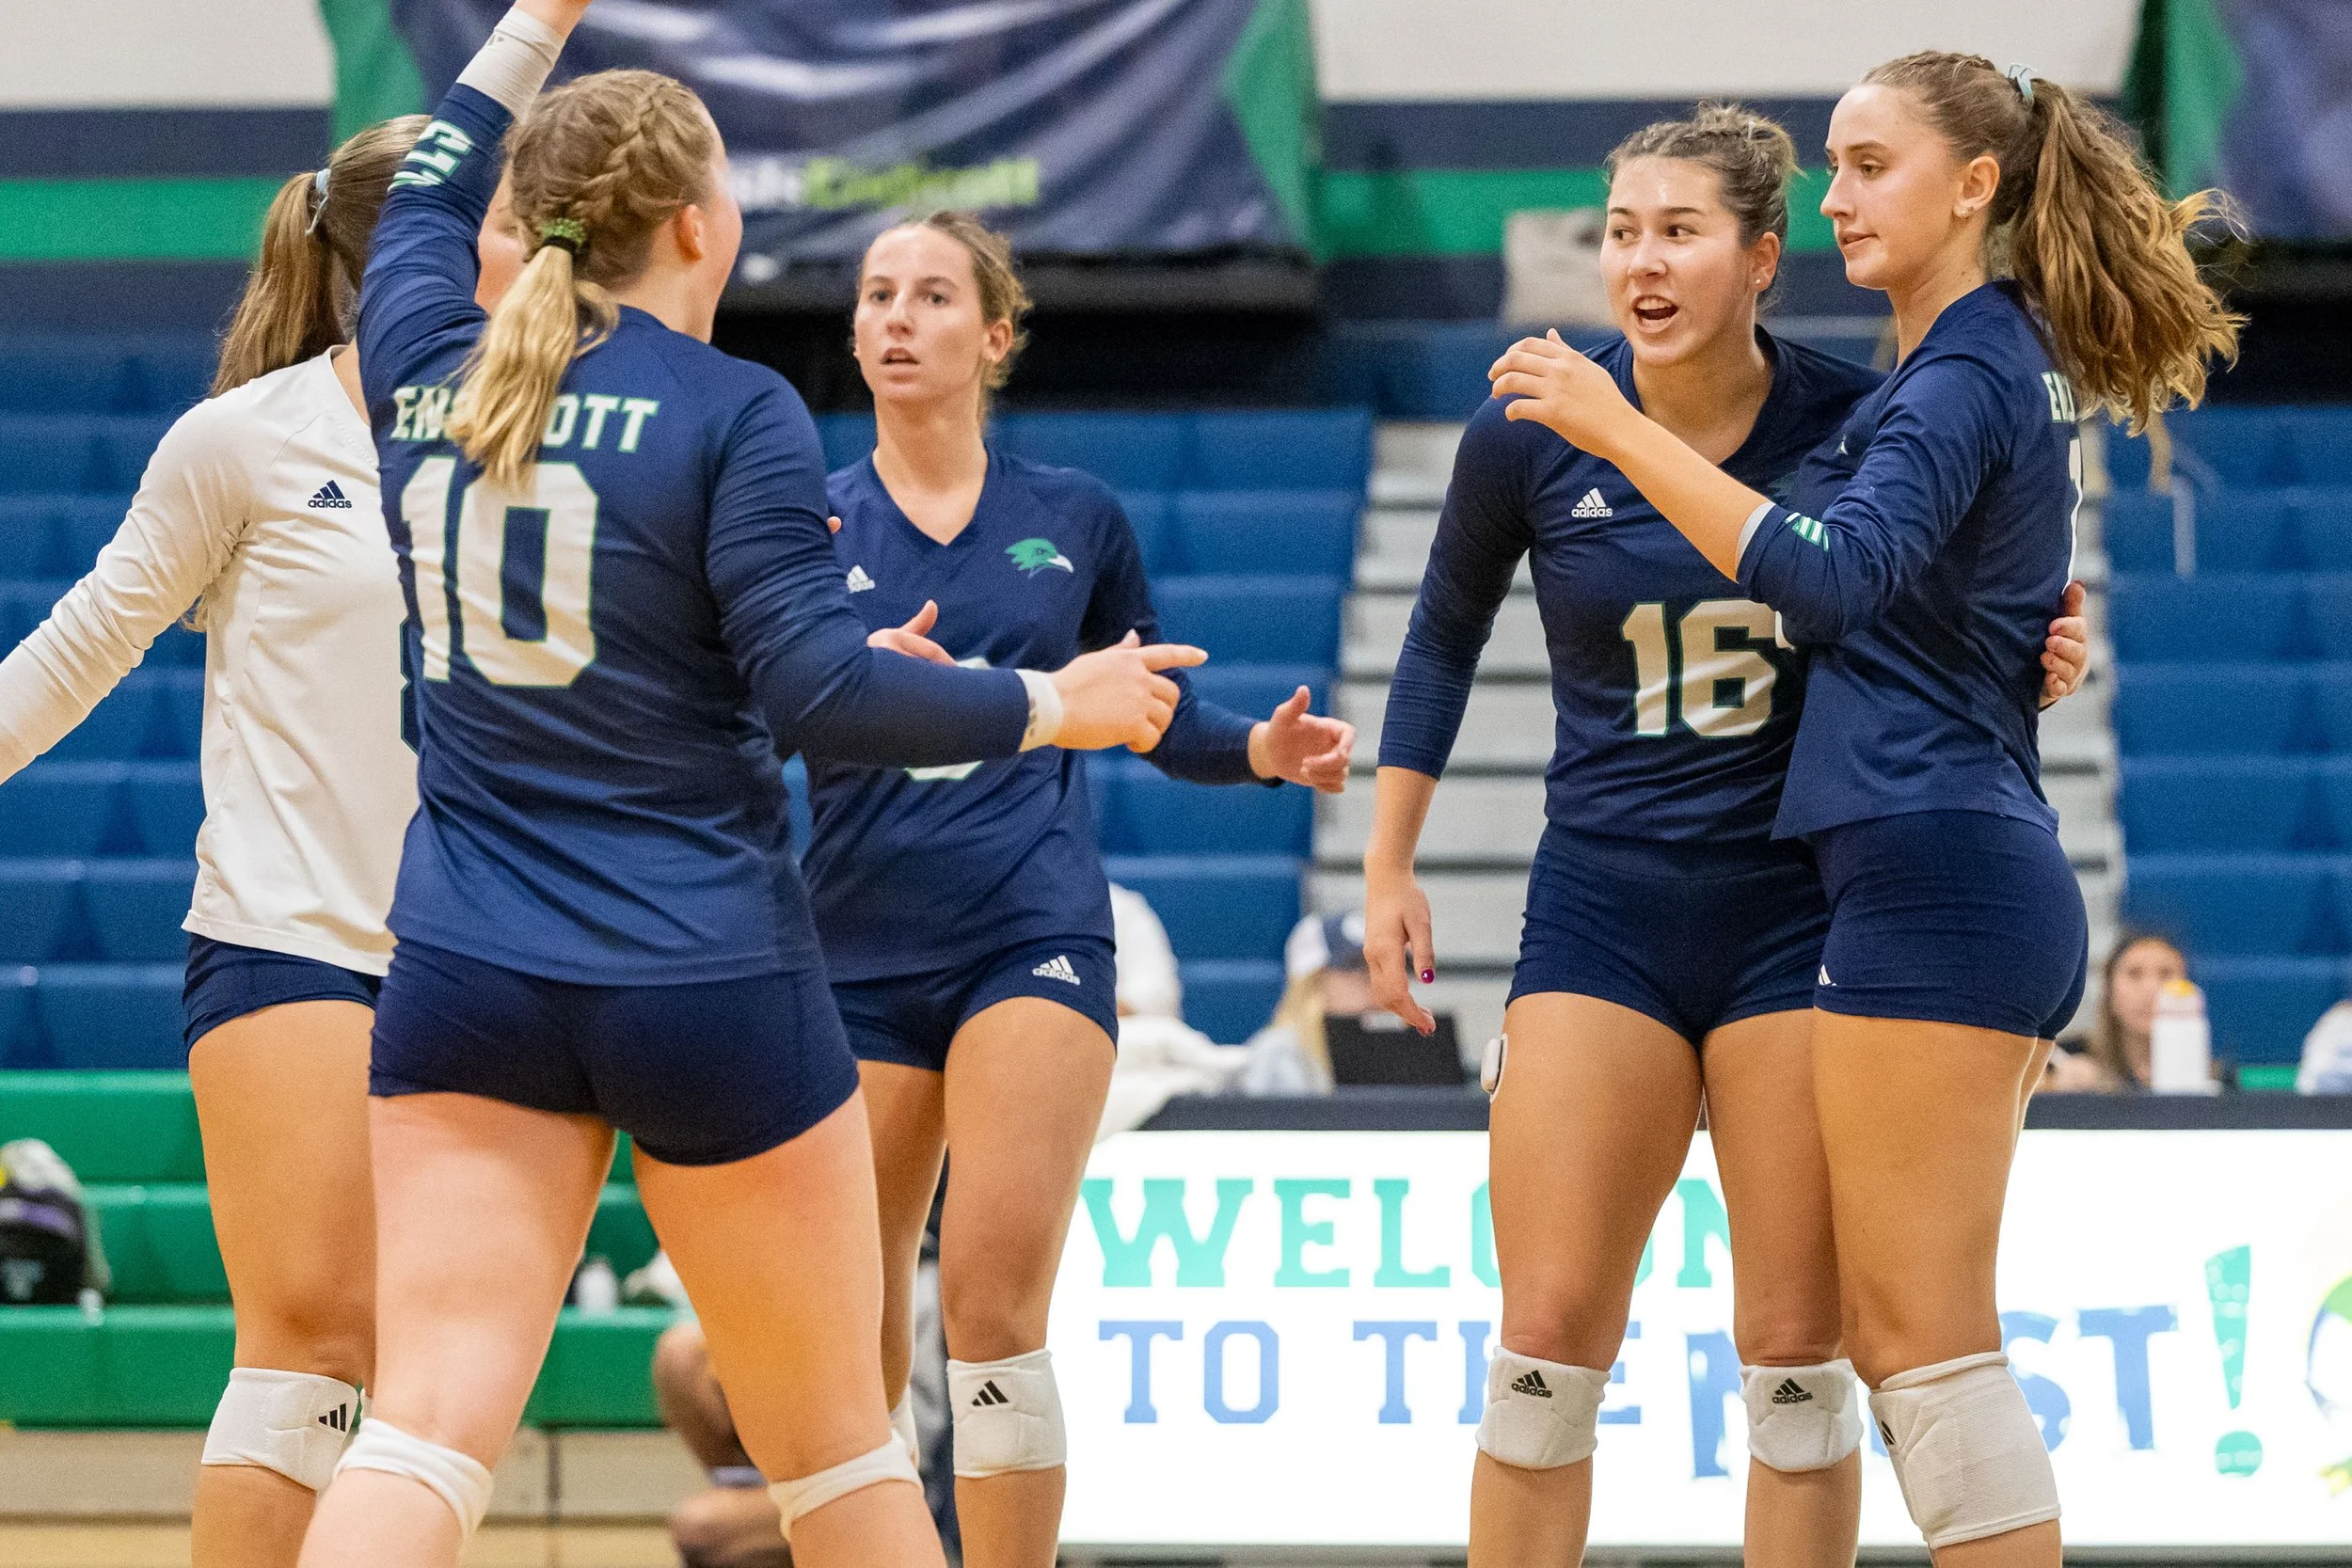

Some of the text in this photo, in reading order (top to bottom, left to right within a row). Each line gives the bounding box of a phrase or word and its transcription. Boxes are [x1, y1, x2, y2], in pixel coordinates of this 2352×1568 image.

[389, 384, 660, 453] ENOTT
[307, 498, 353, 509] adidas
[1571, 506, 1613, 518] adidas
[400, 454, 599, 689] 10
[1621, 597, 1796, 738] 16
[1098, 1321, 1279, 1424] TO
[1511, 1383, 1552, 1399] adidas
[1772, 1392, 1813, 1404] adidas
